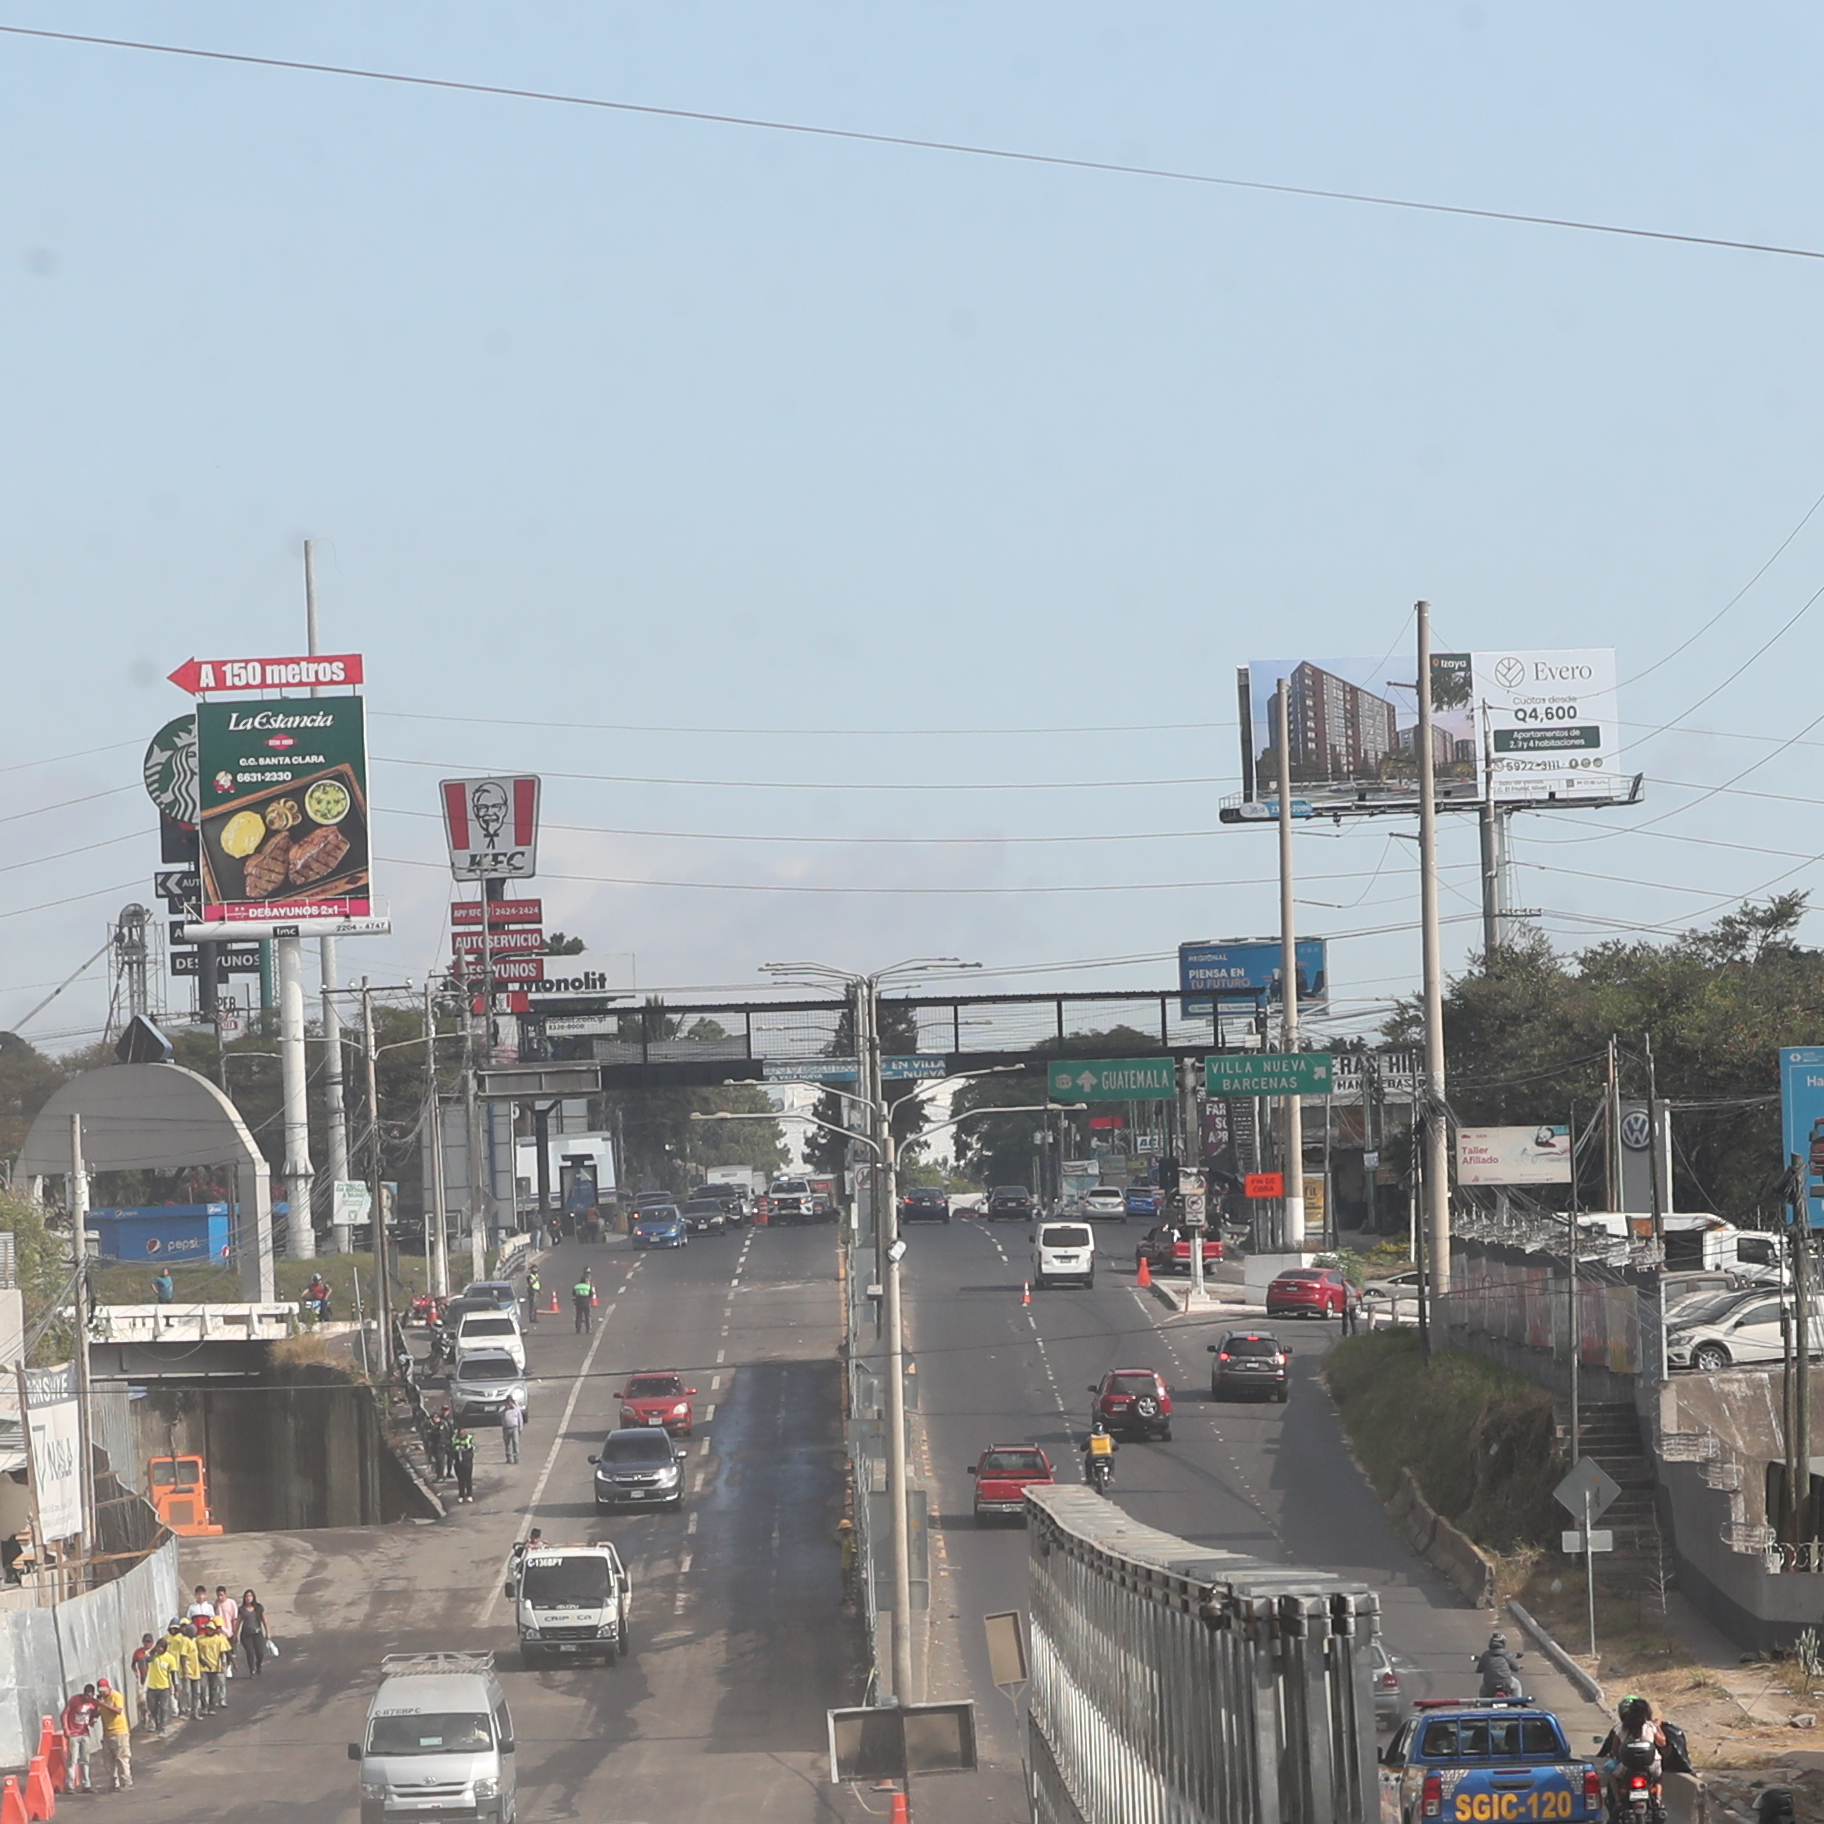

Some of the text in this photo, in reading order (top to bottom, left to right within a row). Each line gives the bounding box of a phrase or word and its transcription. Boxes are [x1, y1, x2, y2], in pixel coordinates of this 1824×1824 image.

[199, 660, 346, 688] A 150 metros
[1533, 660, 1593, 682] Evero
[1512, 696, 1546, 706] Cuotas
[1514, 705, 1578, 723] Q4,600
[1512, 729, 1569, 740] Apartamentos
[259, 755, 291, 766] SANTA
[292, 754, 326, 765] CLARA
[467, 851, 526, 873] KFC
[248, 905, 339, 919] DESAYUNOS 2x1
[494, 905, 539, 916] 2424-2424
[365, 921, 386, 931] 4747
[455, 933, 541, 949] AUTOSERVICIO
[176, 953, 260, 969] DESYUNOS
[464, 962, 537, 979] DESYUNOS
[1188, 967, 1245, 979] PIENSA EN
[1190, 977, 1251, 989] TU FUTURO
[891, 1059, 946, 1070] EN VILLA
[1211, 1059, 1307, 1075] VILLA NUEVA
[902, 1069, 946, 1078] NUEVA
[1101, 1069, 1170, 1091] GUATEMALA
[1222, 1077, 1298, 1091] BARCENAS
[1461, 1146, 1489, 1155] Taller
[1462, 1156, 1499, 1166] Afiliado
[167, 1237, 199, 1252] pepsi
[1455, 1790, 1573, 1821] SGIC-120
